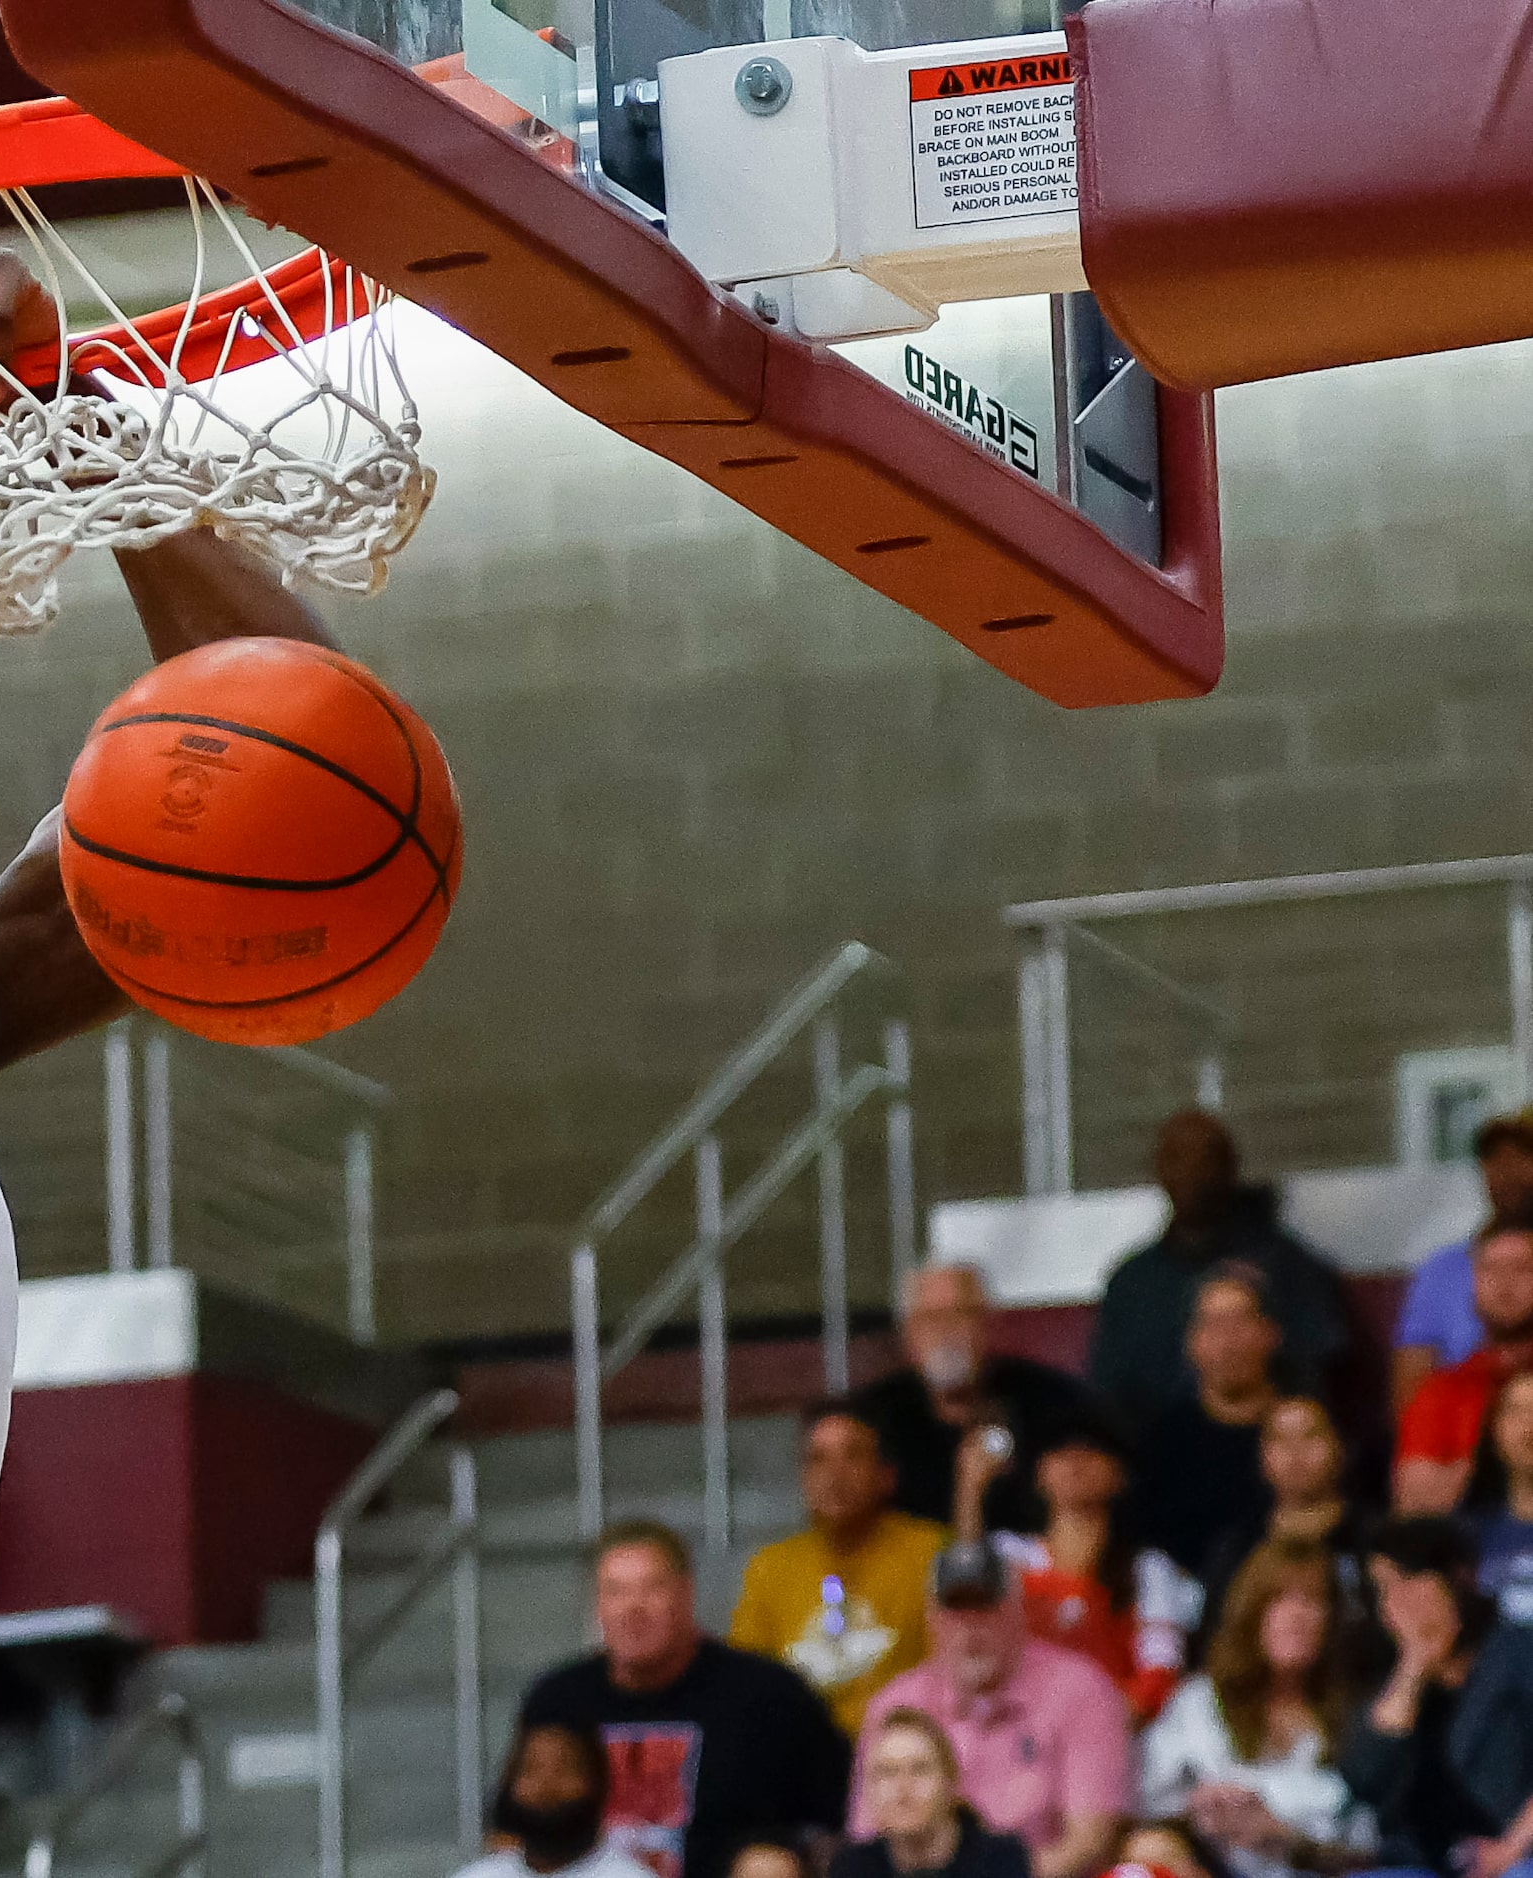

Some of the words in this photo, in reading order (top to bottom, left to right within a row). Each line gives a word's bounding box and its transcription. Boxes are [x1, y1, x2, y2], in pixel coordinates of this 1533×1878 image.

[934, 109, 953, 121] DO
[956, 105, 982, 118] NOT
[986, 98, 1040, 114] REMOVE
[934, 121, 985, 137] BEFORE
[988, 112, 1061, 130] INSTALLING
[918, 139, 961, 154] BRACE
[965, 137, 983, 148] ON
[986, 132, 1017, 146] MAIN
[1021, 127, 1059, 142] BOOM
[937, 148, 1015, 167] BACKBOARD
[1018, 140, 1077, 157] WITHOUT
[939, 164, 1007, 182] INSTALLED
[1011, 159, 1055, 174] COULD
[944, 181, 1000, 197] SERIOUS
[1004, 172, 1071, 190] PERSONAL
[952, 196, 1001, 212] AND/OR
[1004, 189, 1057, 206] DAMAGE
[1061, 187, 1079, 199] TO
